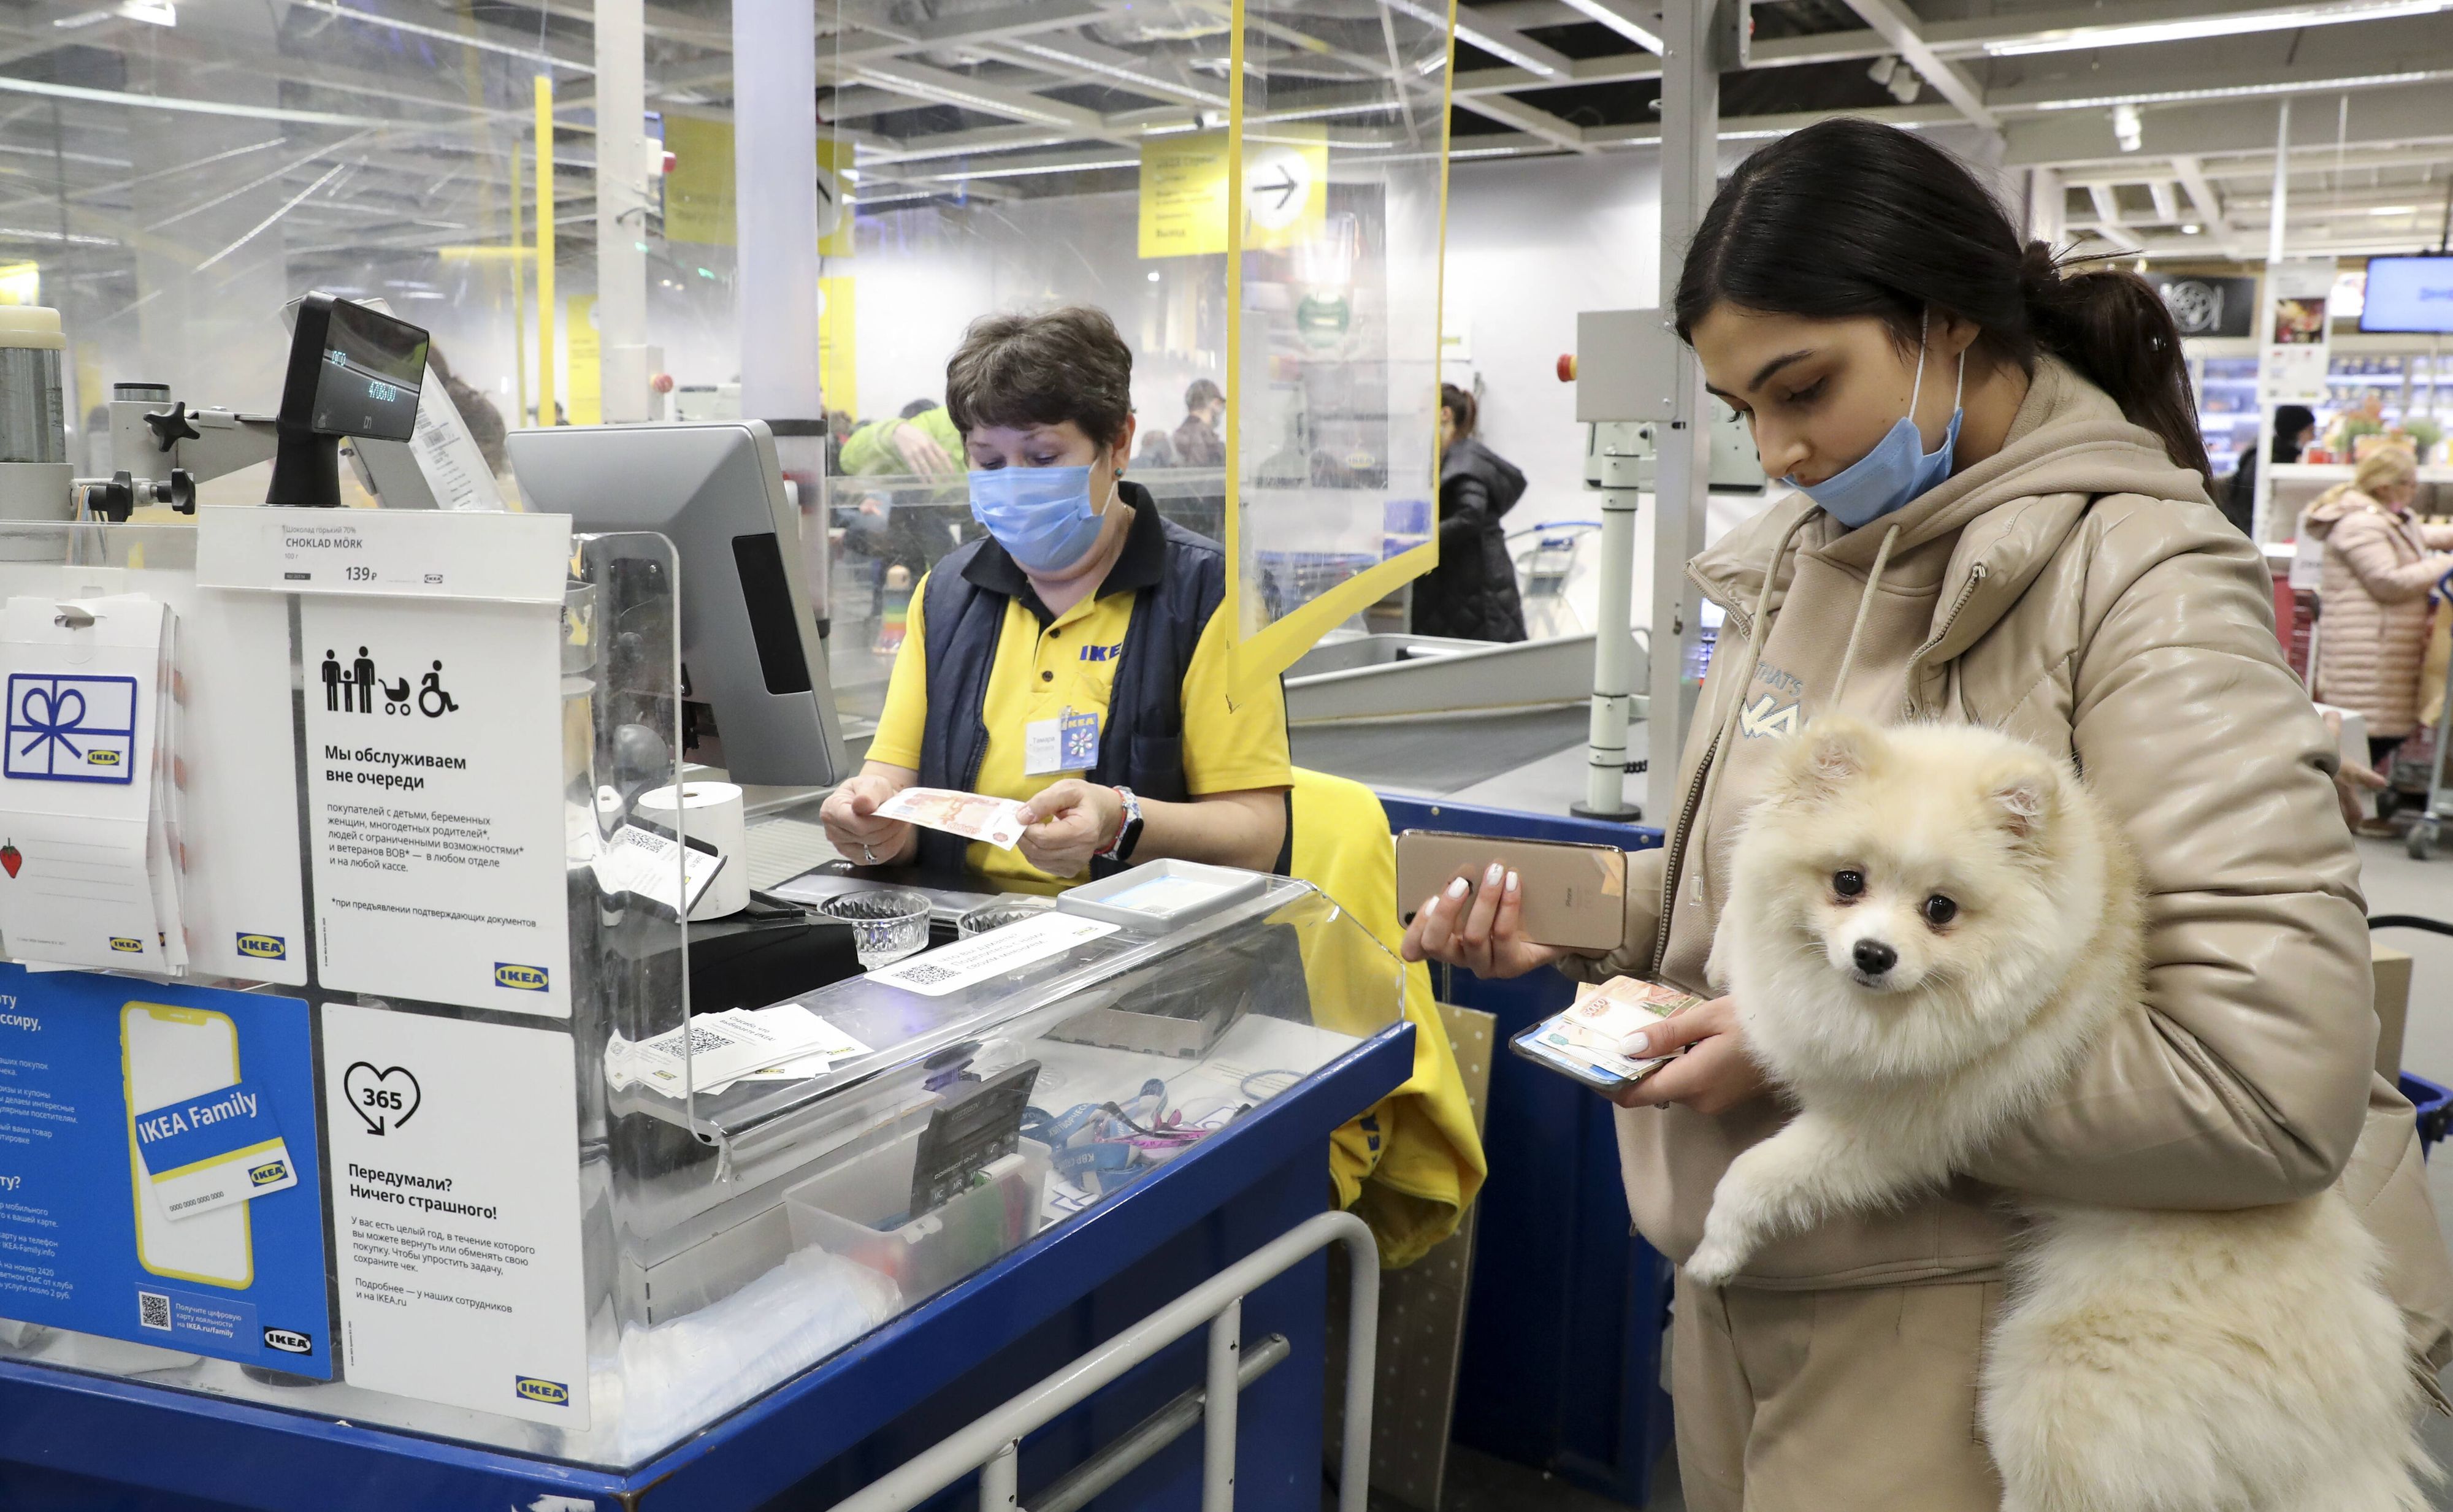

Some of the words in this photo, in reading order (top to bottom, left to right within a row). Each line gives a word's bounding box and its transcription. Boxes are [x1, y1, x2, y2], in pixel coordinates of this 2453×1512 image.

[286, 526, 315, 535] Шоколад
[286, 538, 331, 549] CHOKLAD
[333, 537, 363, 549] MÖRK
[1079, 642, 1123, 662] IKE
[1753, 661, 1805, 698] THAT'S
[325, 745, 351, 760] Мы
[354, 747, 467, 769] обслуживаем
[326, 770, 353, 782] вне
[357, 771, 424, 791] очереди
[327, 803, 385, 817] покупателей
[393, 809, 429, 821] детьми,
[431, 811, 491, 825] беременных
[327, 817, 367, 829] женщин,
[369, 821, 431, 834] многодетных
[328, 830, 358, 841] людей
[365, 834, 441, 847] ограниченными
[337, 844, 384, 856] ветеранов
[434, 853, 466, 864] любом
[468, 857, 500, 868] отделе
[350, 858, 380, 869] любой
[382, 863, 409, 872] кассе.
[352, 899, 411, 915] предъявлении
[412, 907, 486, 923] подтверждающих
[486, 914, 537, 928] документов
[0, 994, 17, 1010] ту
[1582, 998, 1607, 1018] 5000
[19, 1060, 48, 1071] покупок
[24, 1089, 51, 1099] купоны
[363, 1088, 402, 1110] 365
[5, 1096, 31, 1105] делаем
[32, 1101, 75, 1113] интересные
[31, 1110, 78, 1124] посетителям.
[138, 1112, 189, 1144] IKEA
[188, 1091, 258, 1129] Family
[12, 1125, 31, 1134] вами
[31, 1129, 53, 1139] товар
[348, 1163, 453, 1191] Передумали?
[952, 1178, 962, 1191] MR
[350, 1183, 405, 1205] Ничего
[408, 1195, 497, 1220] страшного!
[934, 1189, 943, 1200] MC
[5, 1203, 48, 1216] мобильного
[12, 1214, 36, 1223] вашей
[37, 1218, 59, 1228] карте.
[29, 1236, 58, 1248] телефон
[351, 1216, 358, 1224] У
[359, 1219, 373, 1228] вас
[375, 1221, 395, 1231] есть
[396, 1225, 426, 1237] целый
[427, 1230, 445, 1242] год,
[454, 1234, 491, 1248] течение
[494, 1241, 535, 1255] которого
[352, 1230, 364, 1239] вы
[366, 1232, 399, 1245] можете
[400, 1238, 437, 1251] вернуть
[438, 1245, 457, 1254] или
[458, 1248, 503, 1262] обменять
[505, 1255, 529, 1266] свою
[353, 1242, 391, 1257] покупку.
[392, 1247, 421, 1261] Чтобы
[421, 1254, 469, 1269] упростить
[470, 1262, 503, 1277] задачу,
[353, 1254, 399, 1269] сохраните
[400, 1263, 419, 1272] чек.
[13, 1264, 37, 1275] номер
[37, 1267, 55, 1277] 2420
[4, 1282, 28, 1292] услуги
[29, 1286, 50, 1296] около
[56, 1291, 71, 1300] руб.
[26, 1275, 42, 1285] СМС
[53, 1281, 74, 1290] клуба
[355, 1277, 404, 1294] Подробнее
[416, 1290, 422, 1299] у
[424, 1291, 454, 1303] наших
[455, 1296, 513, 1313] сотрудников
[364, 1292, 375, 1301] на
[376, 1293, 407, 1307] IKEA.ru
[175, 1302, 207, 1315] Получите
[207, 1310, 242, 1322] цифровую
[176, 1313, 195, 1323] карту
[195, 1316, 234, 1329] лояльности
[186, 1323, 234, 1338] IKEA.ru/family
